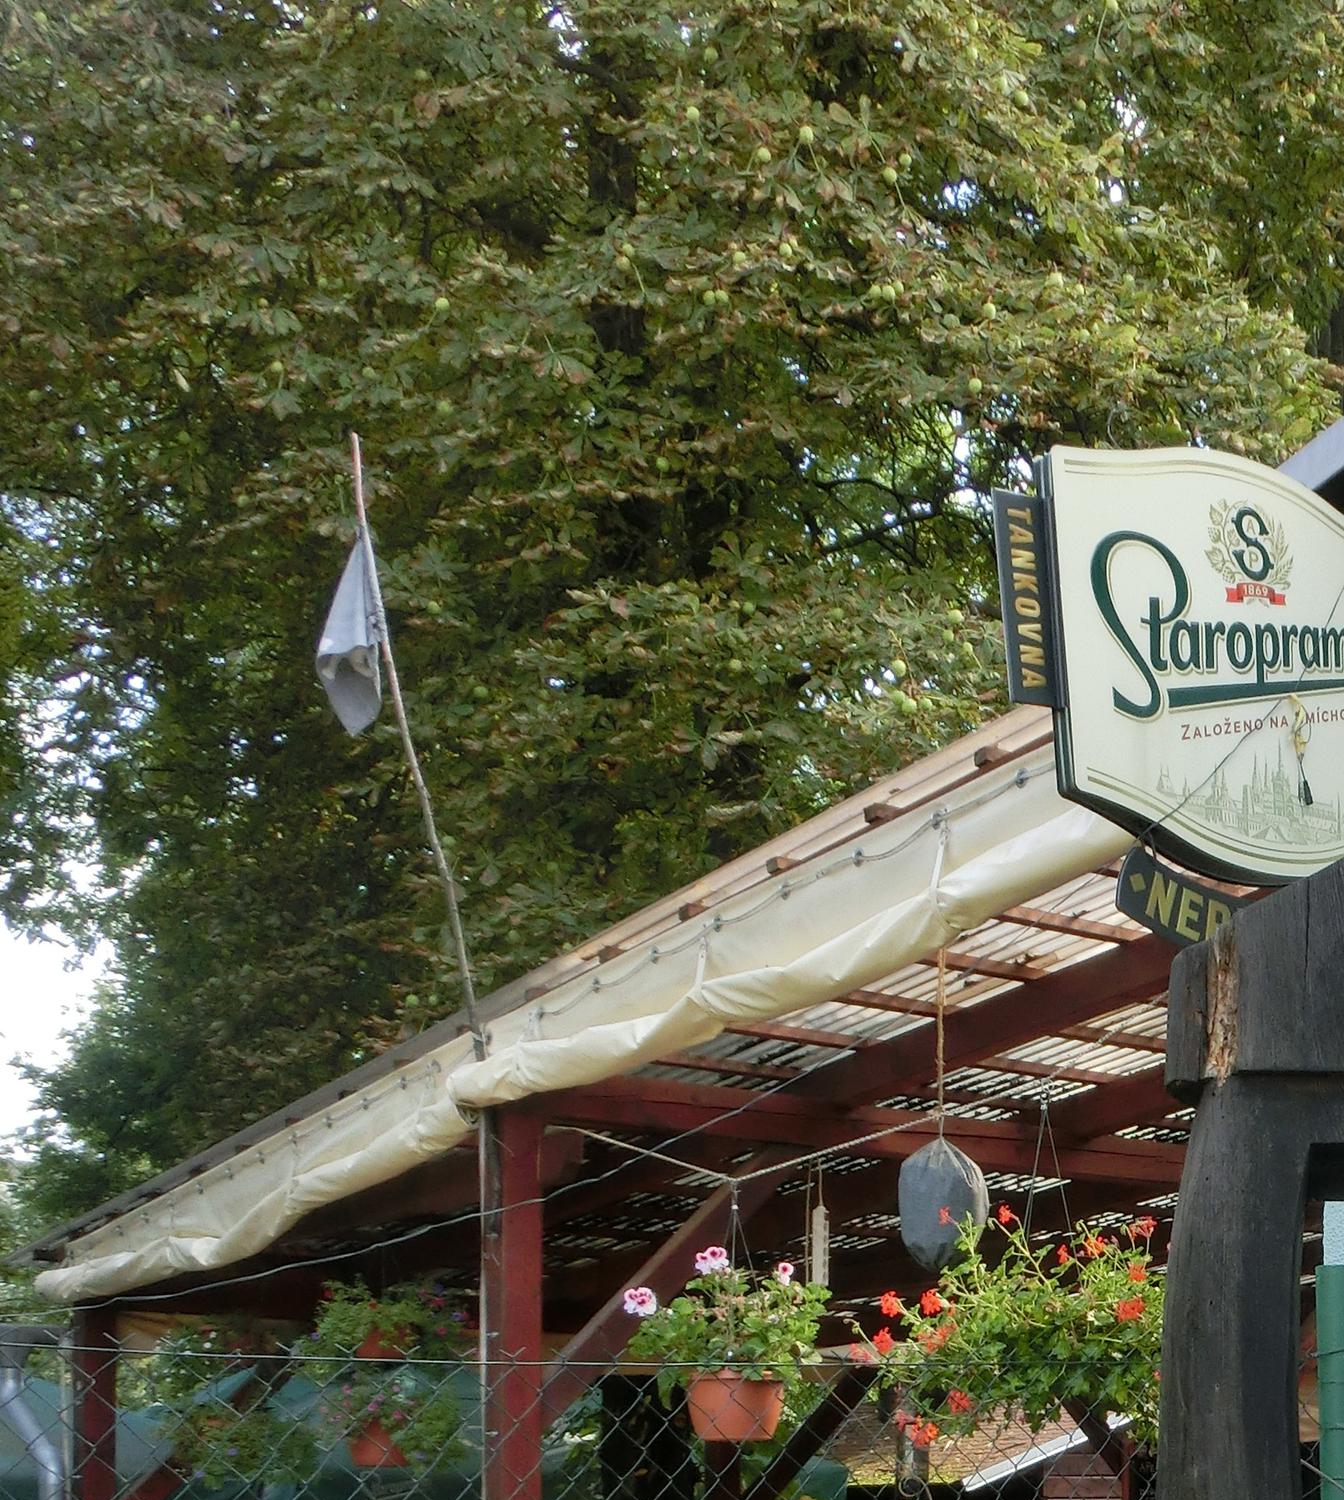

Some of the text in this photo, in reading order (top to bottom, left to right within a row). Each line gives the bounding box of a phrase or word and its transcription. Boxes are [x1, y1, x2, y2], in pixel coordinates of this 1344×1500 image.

[1007, 508, 1047, 689] TANKOVNA
[1243, 584, 1269, 597] 1869
[1181, 717, 1264, 741] ZALOŽENO
[1269, 715, 1289, 730] NA
